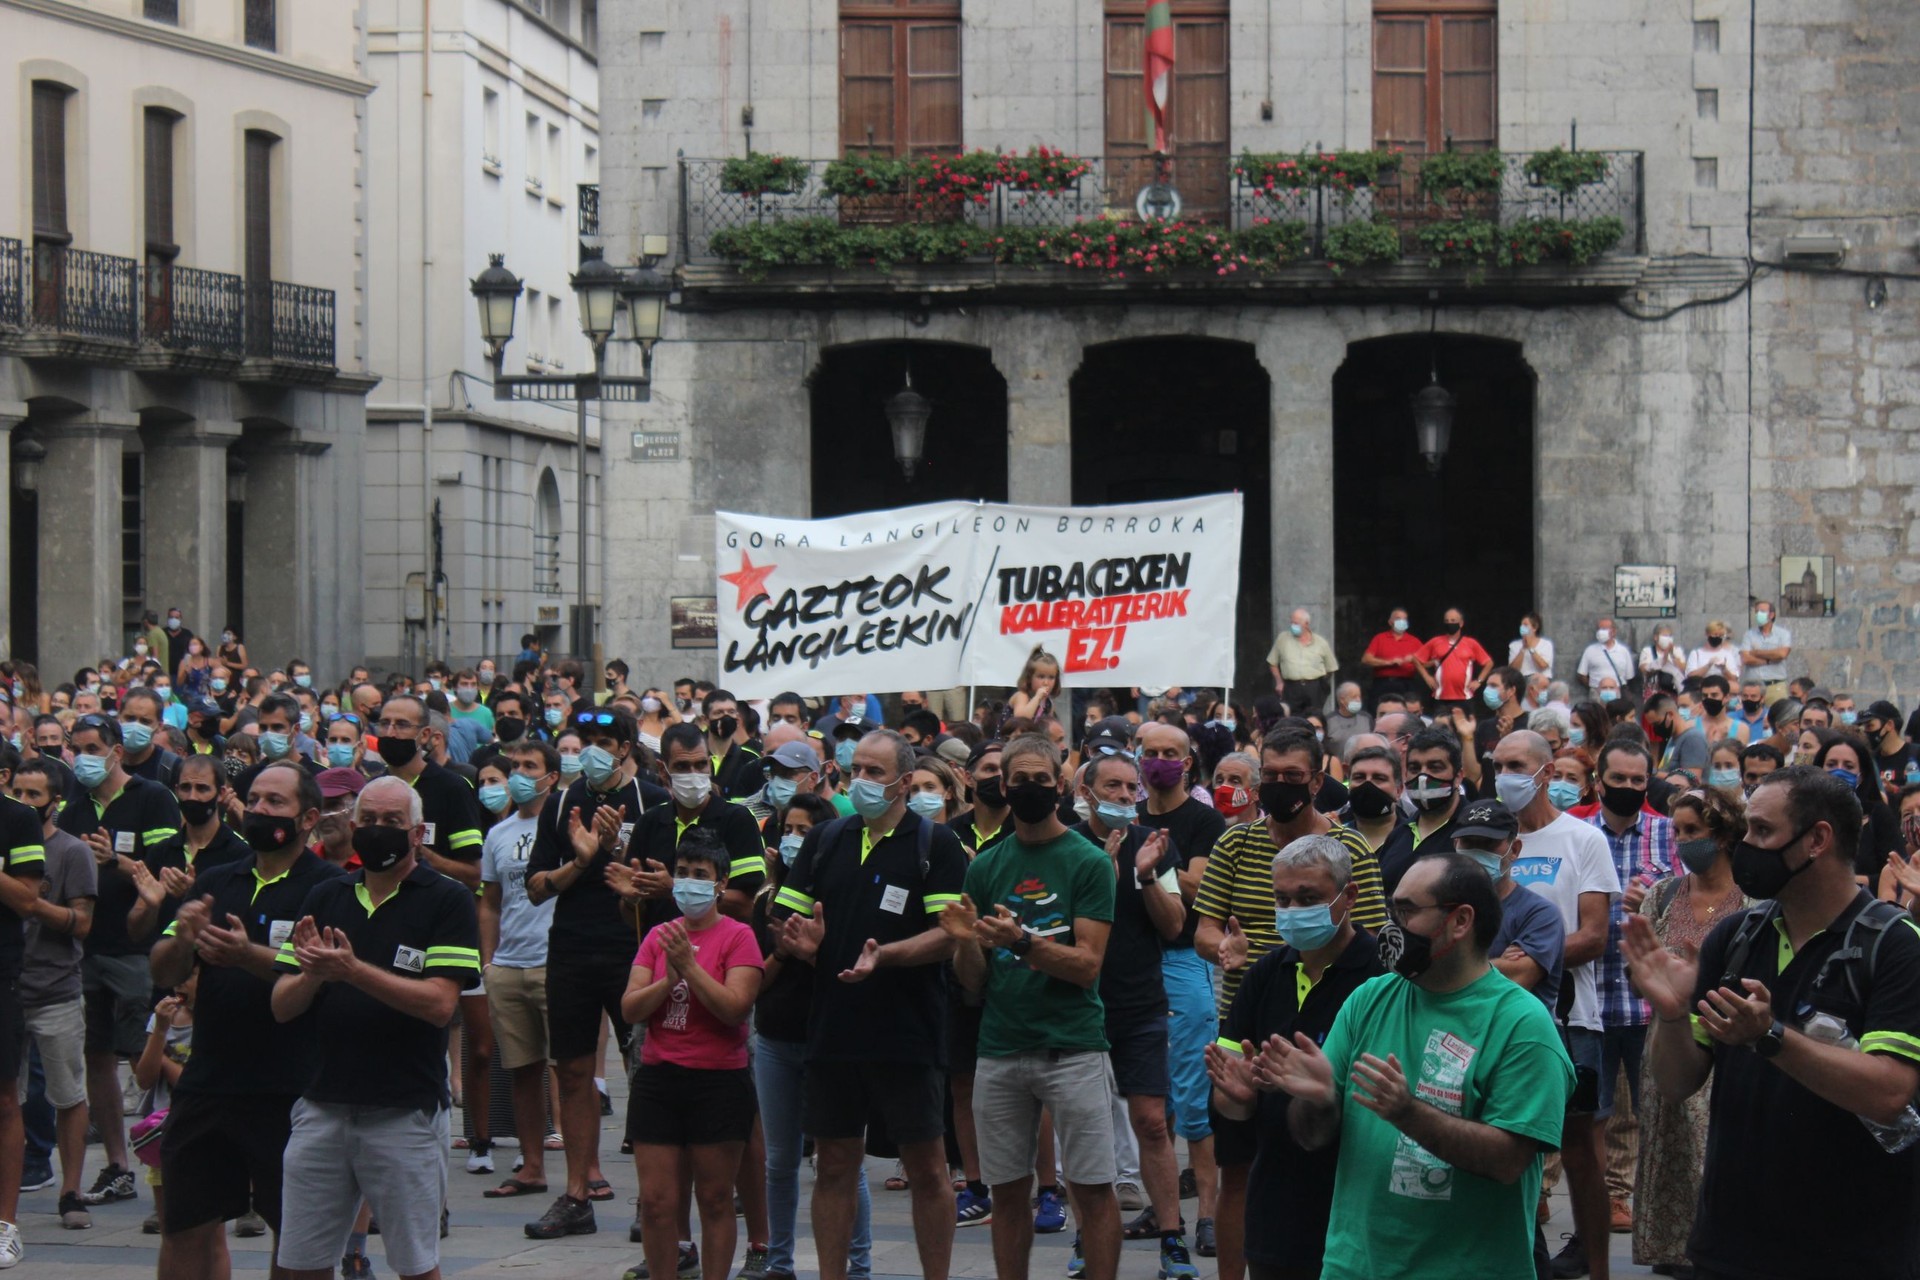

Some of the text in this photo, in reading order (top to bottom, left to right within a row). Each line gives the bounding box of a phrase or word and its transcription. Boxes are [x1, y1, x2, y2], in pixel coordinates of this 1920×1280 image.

[647, 448, 674, 457] PLAZA
[726, 515, 1205, 549] GORA LANGILEON BORROKA
[744, 564, 953, 631] GAZTEOK
[998, 552, 1191, 605] TUBACEXEN
[1000, 589, 1189, 635] KALERATZERIK
[724, 602, 972, 673] LANGILEEKIN
[1065, 626, 1126, 672] EZ!
[1509, 863, 1553, 877] evi's
